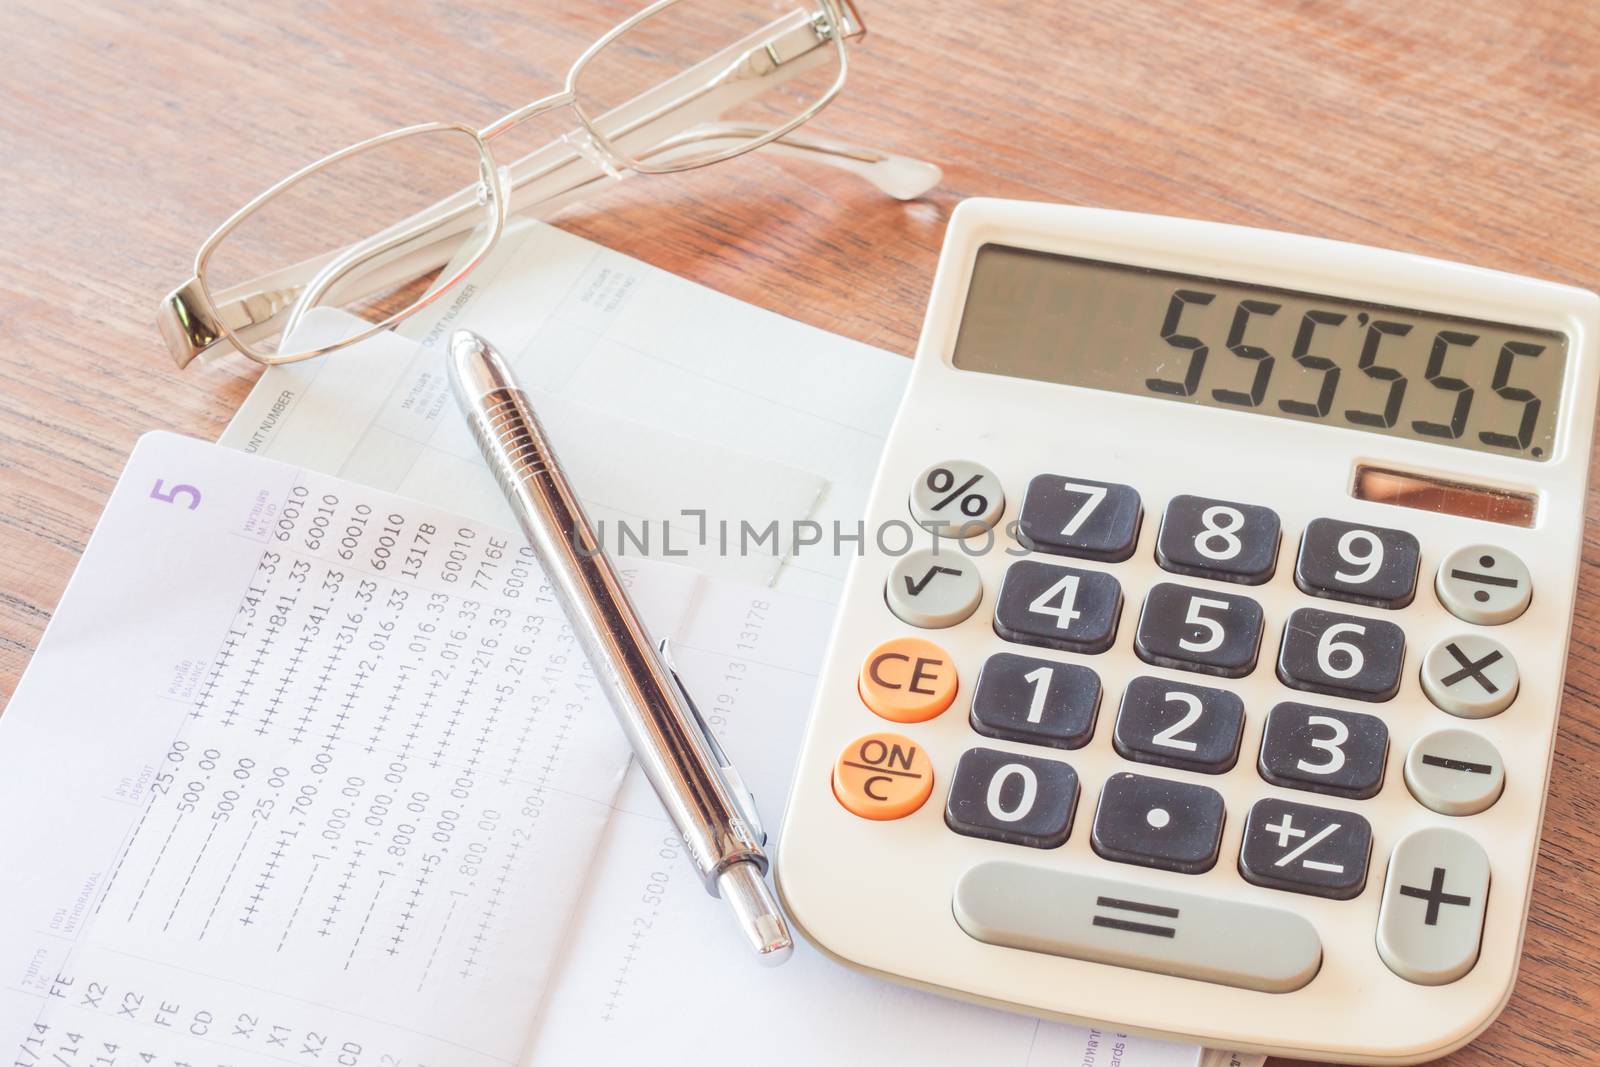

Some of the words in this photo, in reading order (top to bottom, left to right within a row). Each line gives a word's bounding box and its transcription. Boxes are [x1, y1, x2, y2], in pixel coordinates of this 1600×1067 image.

[442, 284, 479, 321] NUMBER
[260, 390, 295, 432] NUMBER
[150, 478, 201, 511] 5
[927, 468, 988, 517] %
[1060, 483, 1107, 536] 7
[1194, 506, 1244, 560] 8
[1334, 530, 1384, 584] 9
[1029, 575, 1081, 629] 4
[1178, 596, 1229, 652] 5
[181, 659, 208, 697] BALANCE
[869, 653, 942, 695] CE
[1317, 623, 1366, 679] 6
[1024, 667, 1053, 723] 1
[1152, 691, 1203, 752] 2
[49, 972, 75, 998] FE
[274, 485, 310, 542] 60010
[80, 982, 109, 1008] X2
[304, 494, 340, 551] 60010
[117, 992, 145, 1018] X2
[337, 503, 373, 561] 60010
[859, 739, 916, 770] ON
[1296, 716, 1350, 775] 3
[129, 763, 154, 800] DEPOSIT
[154, 1000, 181, 1027] FE
[369, 513, 406, 572] 60010
[189, 1010, 214, 1036] CD
[400, 522, 437, 580] 1317B
[231, 1013, 260, 1039] X2
[440, 527, 477, 584] 60010
[266, 1025, 292, 1048] X1
[470, 535, 508, 591] 7716E
[863, 777, 892, 800] C
[986, 763, 1038, 821] 0
[300, 1031, 328, 1058] X2
[502, 545, 536, 599] 60010
[63, 871, 101, 933] WITHDRAWAL
[337, 1042, 363, 1067] CD
